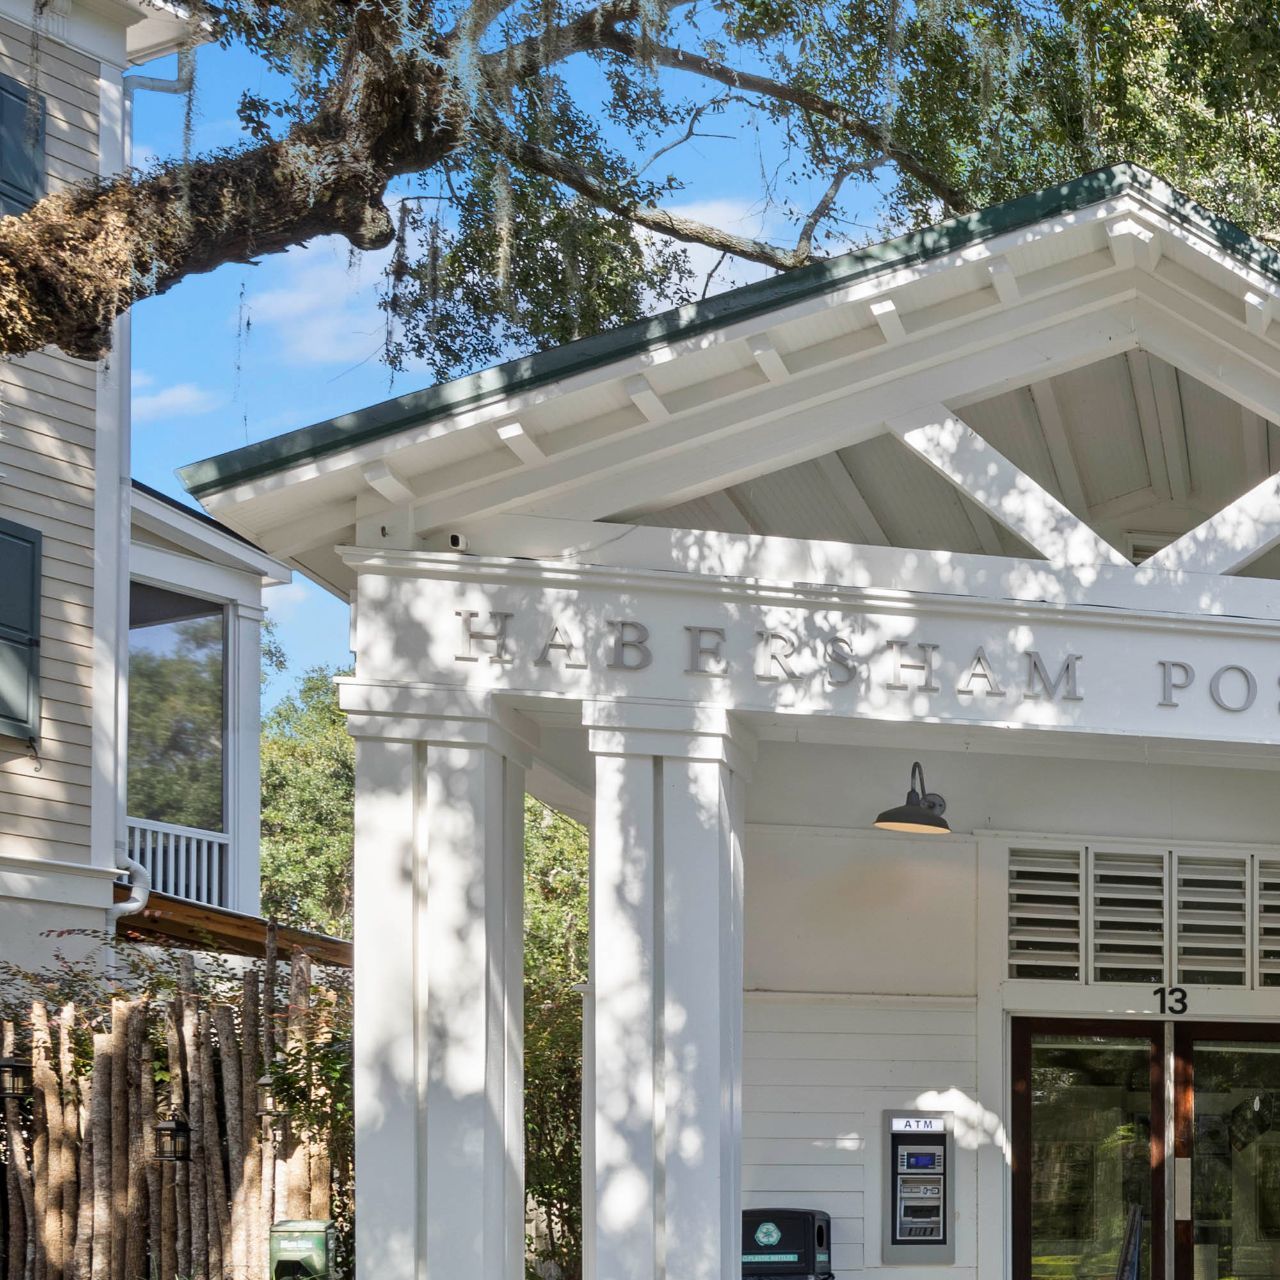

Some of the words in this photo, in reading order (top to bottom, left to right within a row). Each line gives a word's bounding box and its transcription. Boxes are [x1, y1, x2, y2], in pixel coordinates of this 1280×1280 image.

[453, 609, 1083, 701] HABERSHAM
[1152, 987, 1188, 1015] 13
[904, 1120, 933, 1129] ATM
